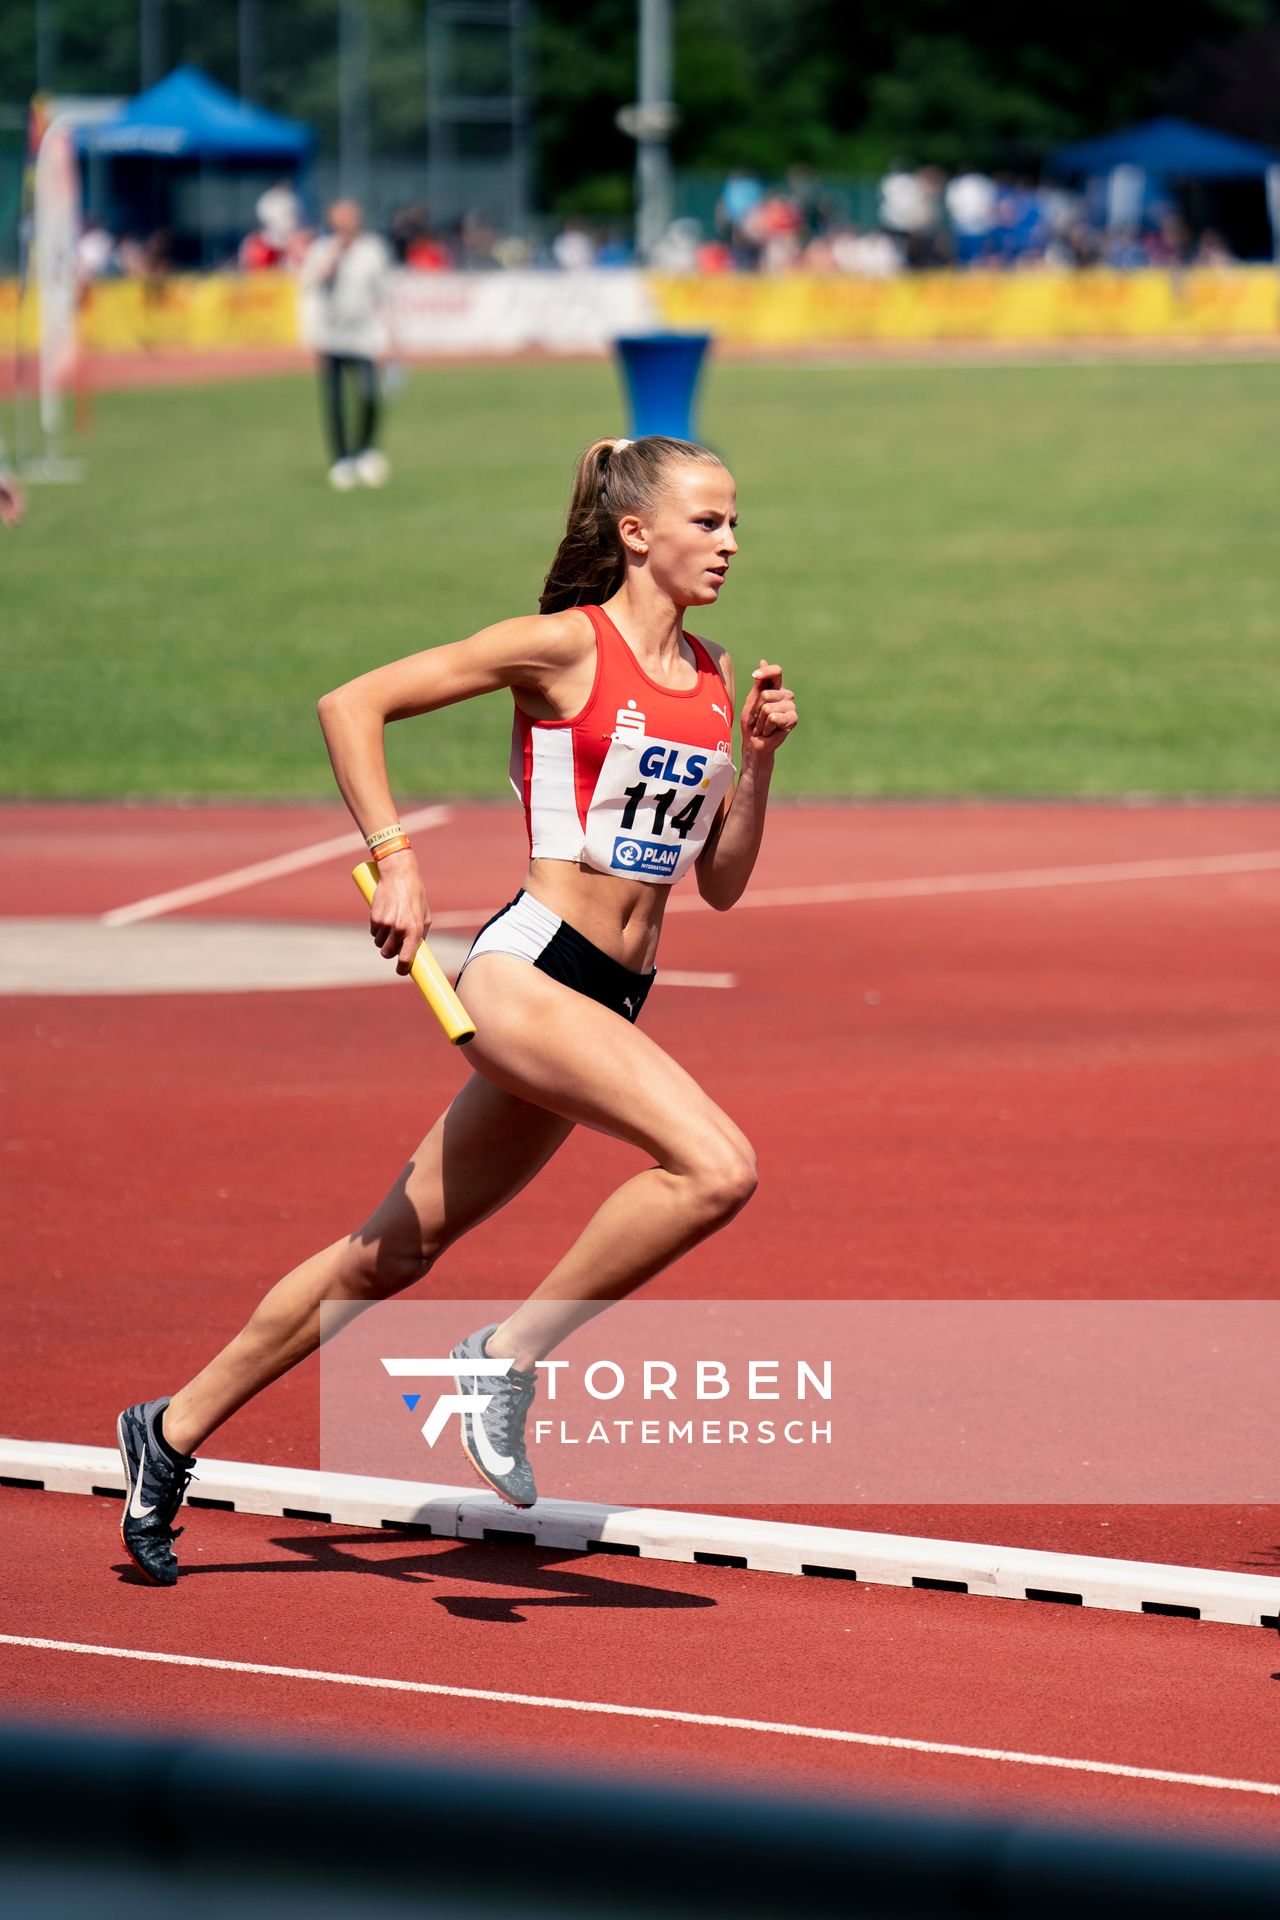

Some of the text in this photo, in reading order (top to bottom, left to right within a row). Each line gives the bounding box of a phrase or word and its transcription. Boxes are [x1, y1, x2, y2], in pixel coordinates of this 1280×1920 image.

[620, 781, 706, 839] 114
[642, 847, 678, 865] PLAN
[640, 863, 672, 873] INTERNATIONAL
